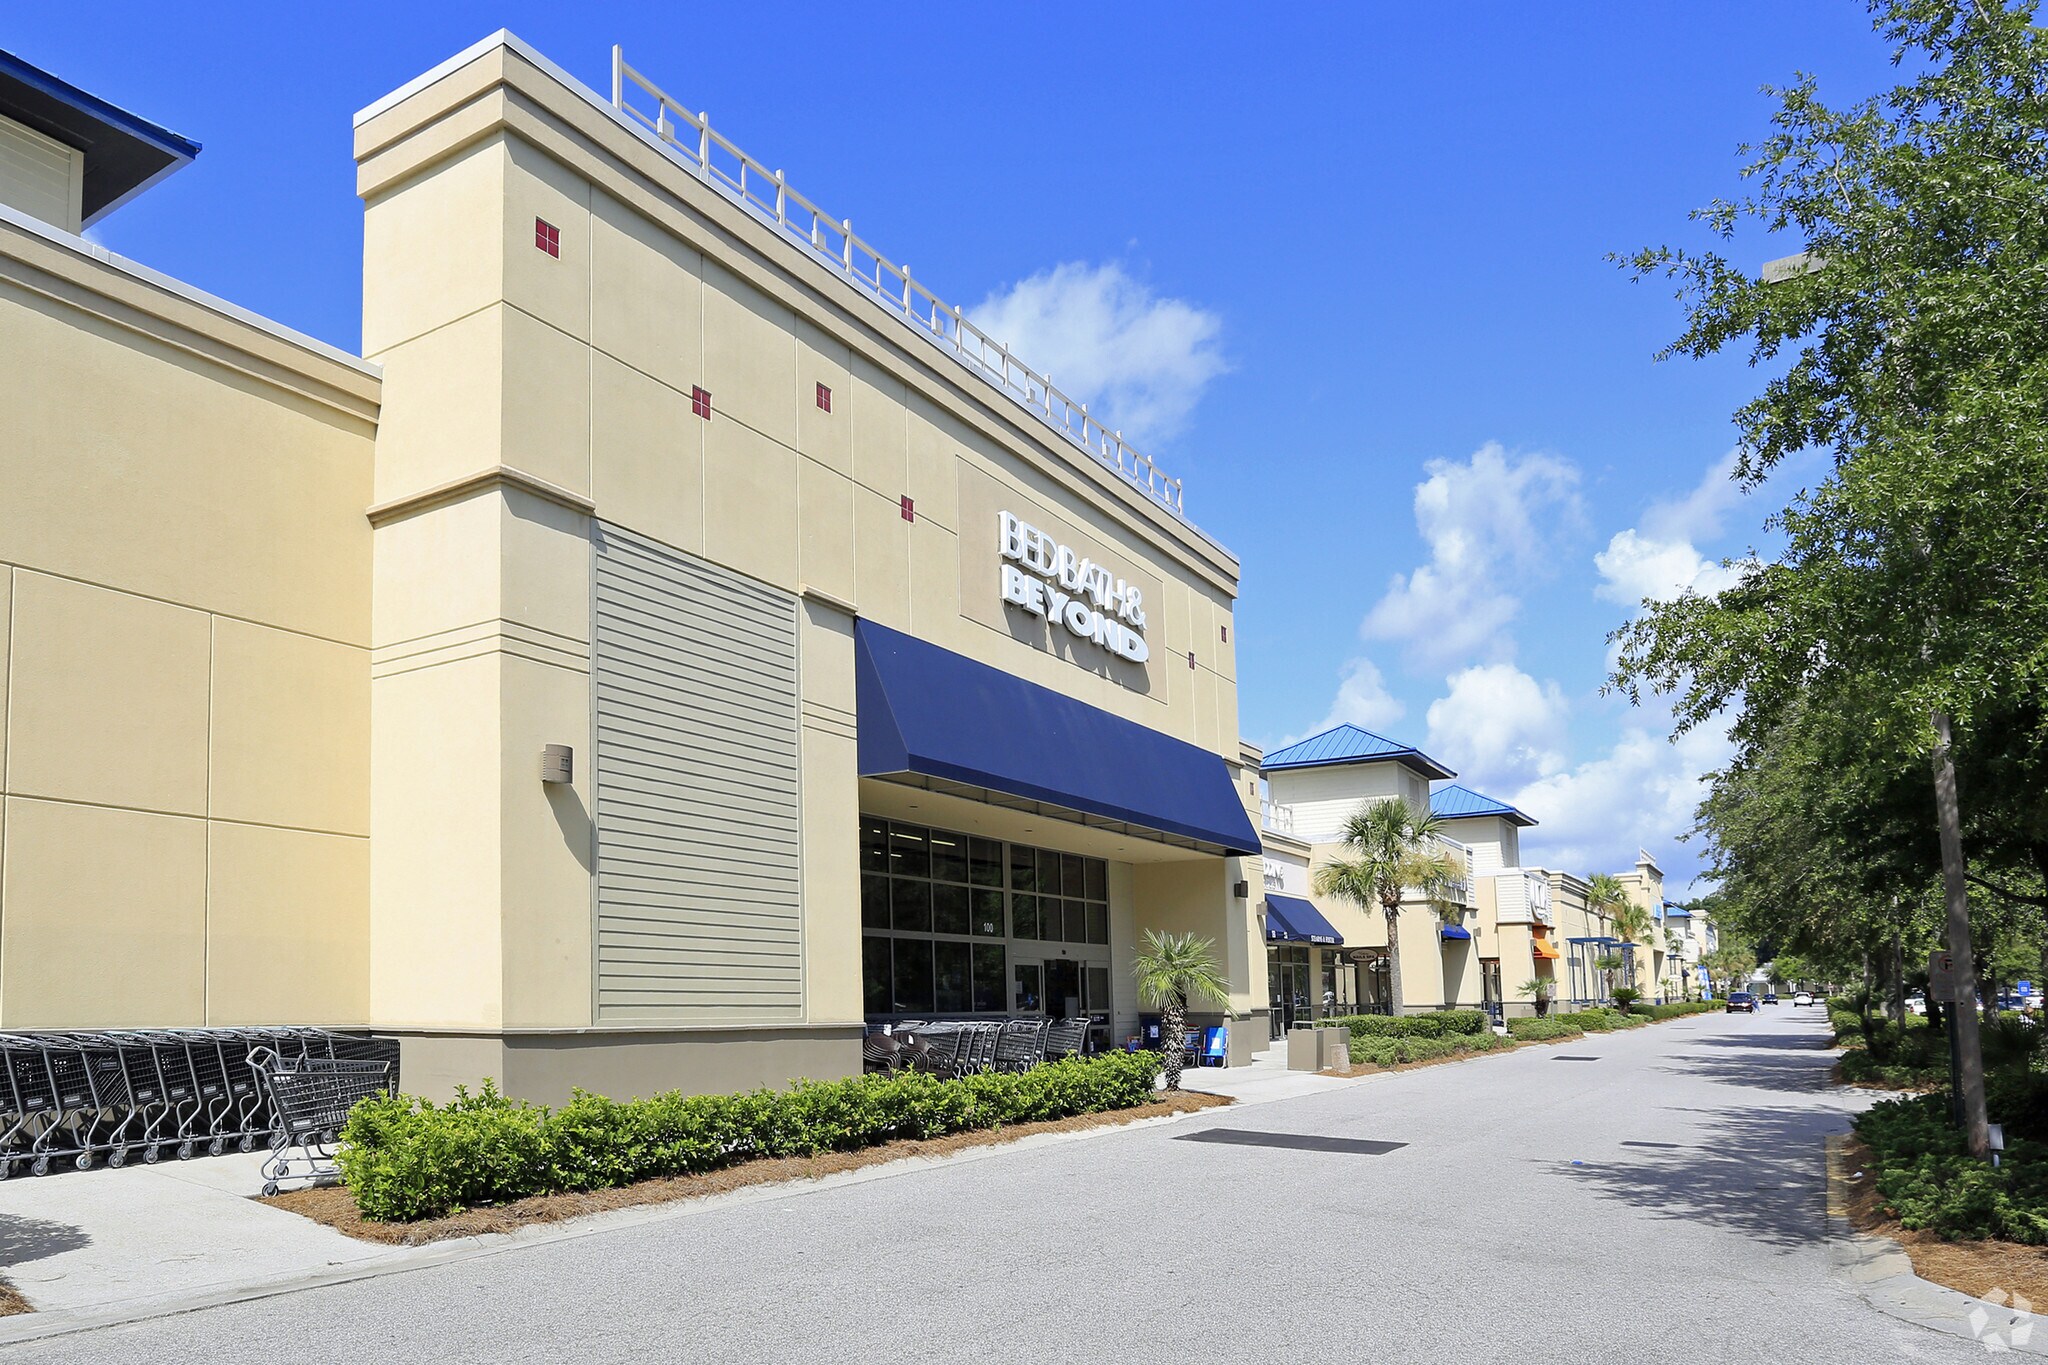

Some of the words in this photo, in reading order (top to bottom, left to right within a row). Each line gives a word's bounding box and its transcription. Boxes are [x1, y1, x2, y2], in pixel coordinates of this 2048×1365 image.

[997, 510, 1059, 577] BED
[1058, 545, 1127, 618] BATH
[1126, 586, 1148, 631] &
[999, 564, 1150, 664] BEYOND
[983, 922, 994, 933] 100
